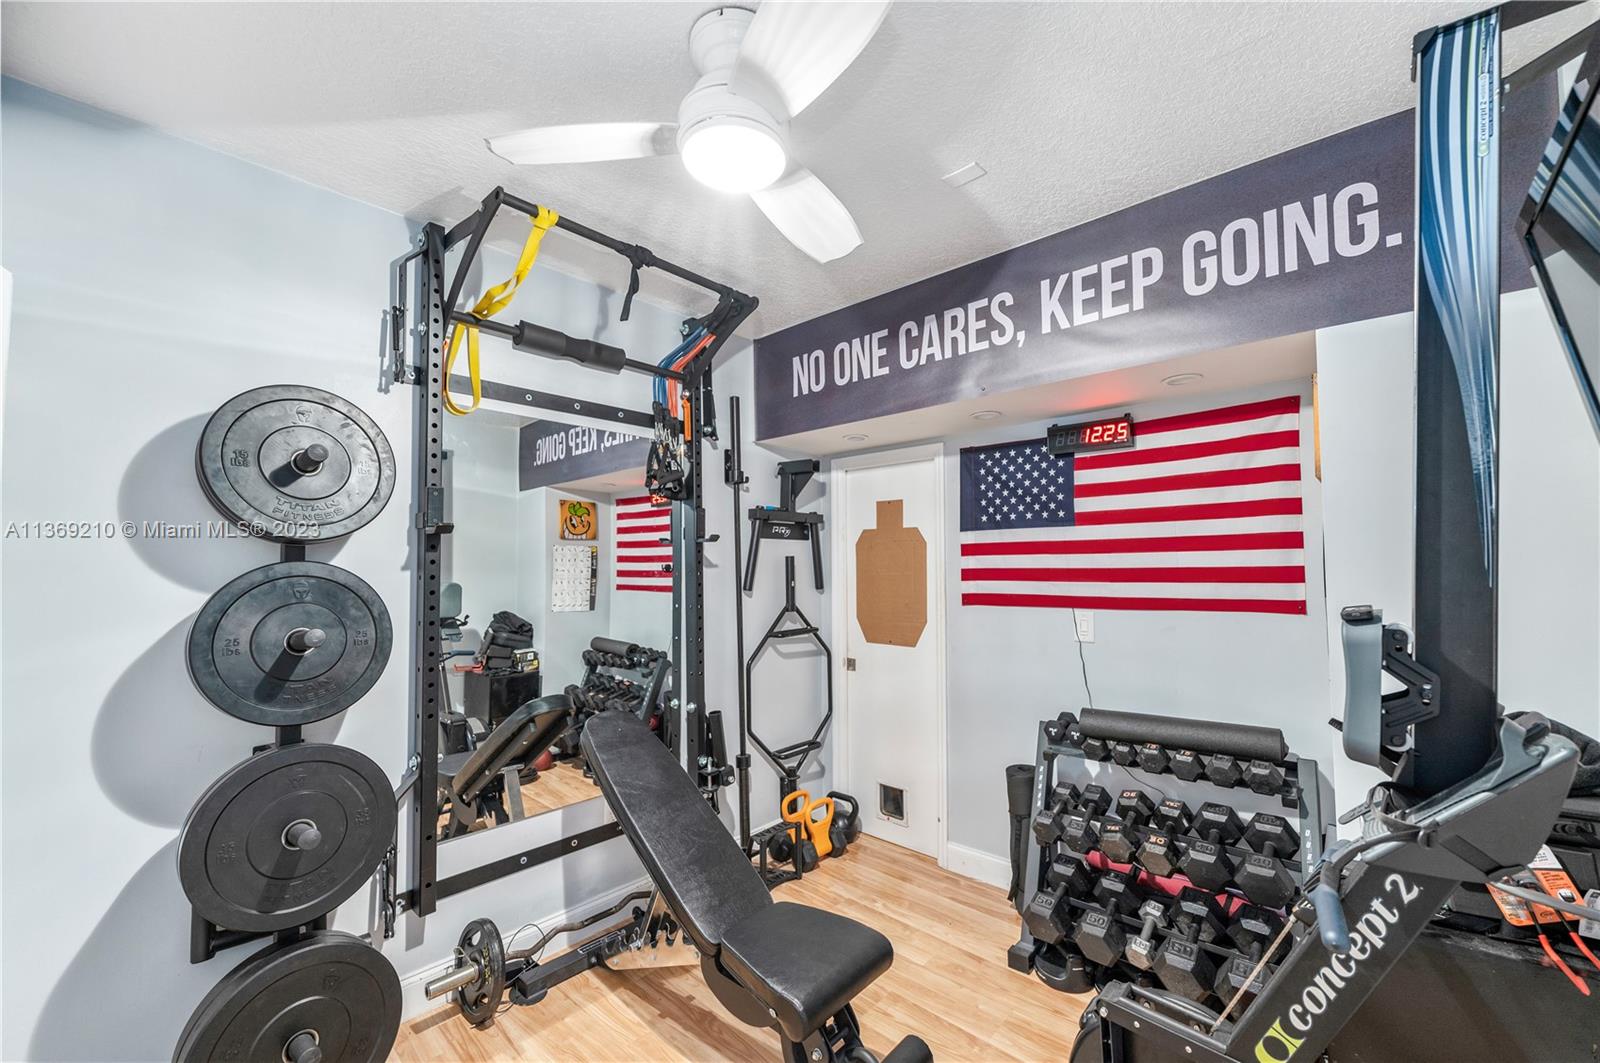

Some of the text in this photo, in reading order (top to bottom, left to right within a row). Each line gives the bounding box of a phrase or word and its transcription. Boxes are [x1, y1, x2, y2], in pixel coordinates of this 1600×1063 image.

[792, 181, 1403, 398] NO ONE CARES, KEEP GOING.
[232, 450, 249, 460] 15
[276, 495, 341, 512] TITAN
[271, 507, 345, 522] FITNESS
[224, 638, 240, 647] 25
[1037, 895, 1054, 907] 50
[1088, 914, 1106, 925] 50
[1289, 897, 1400, 1032] concept
